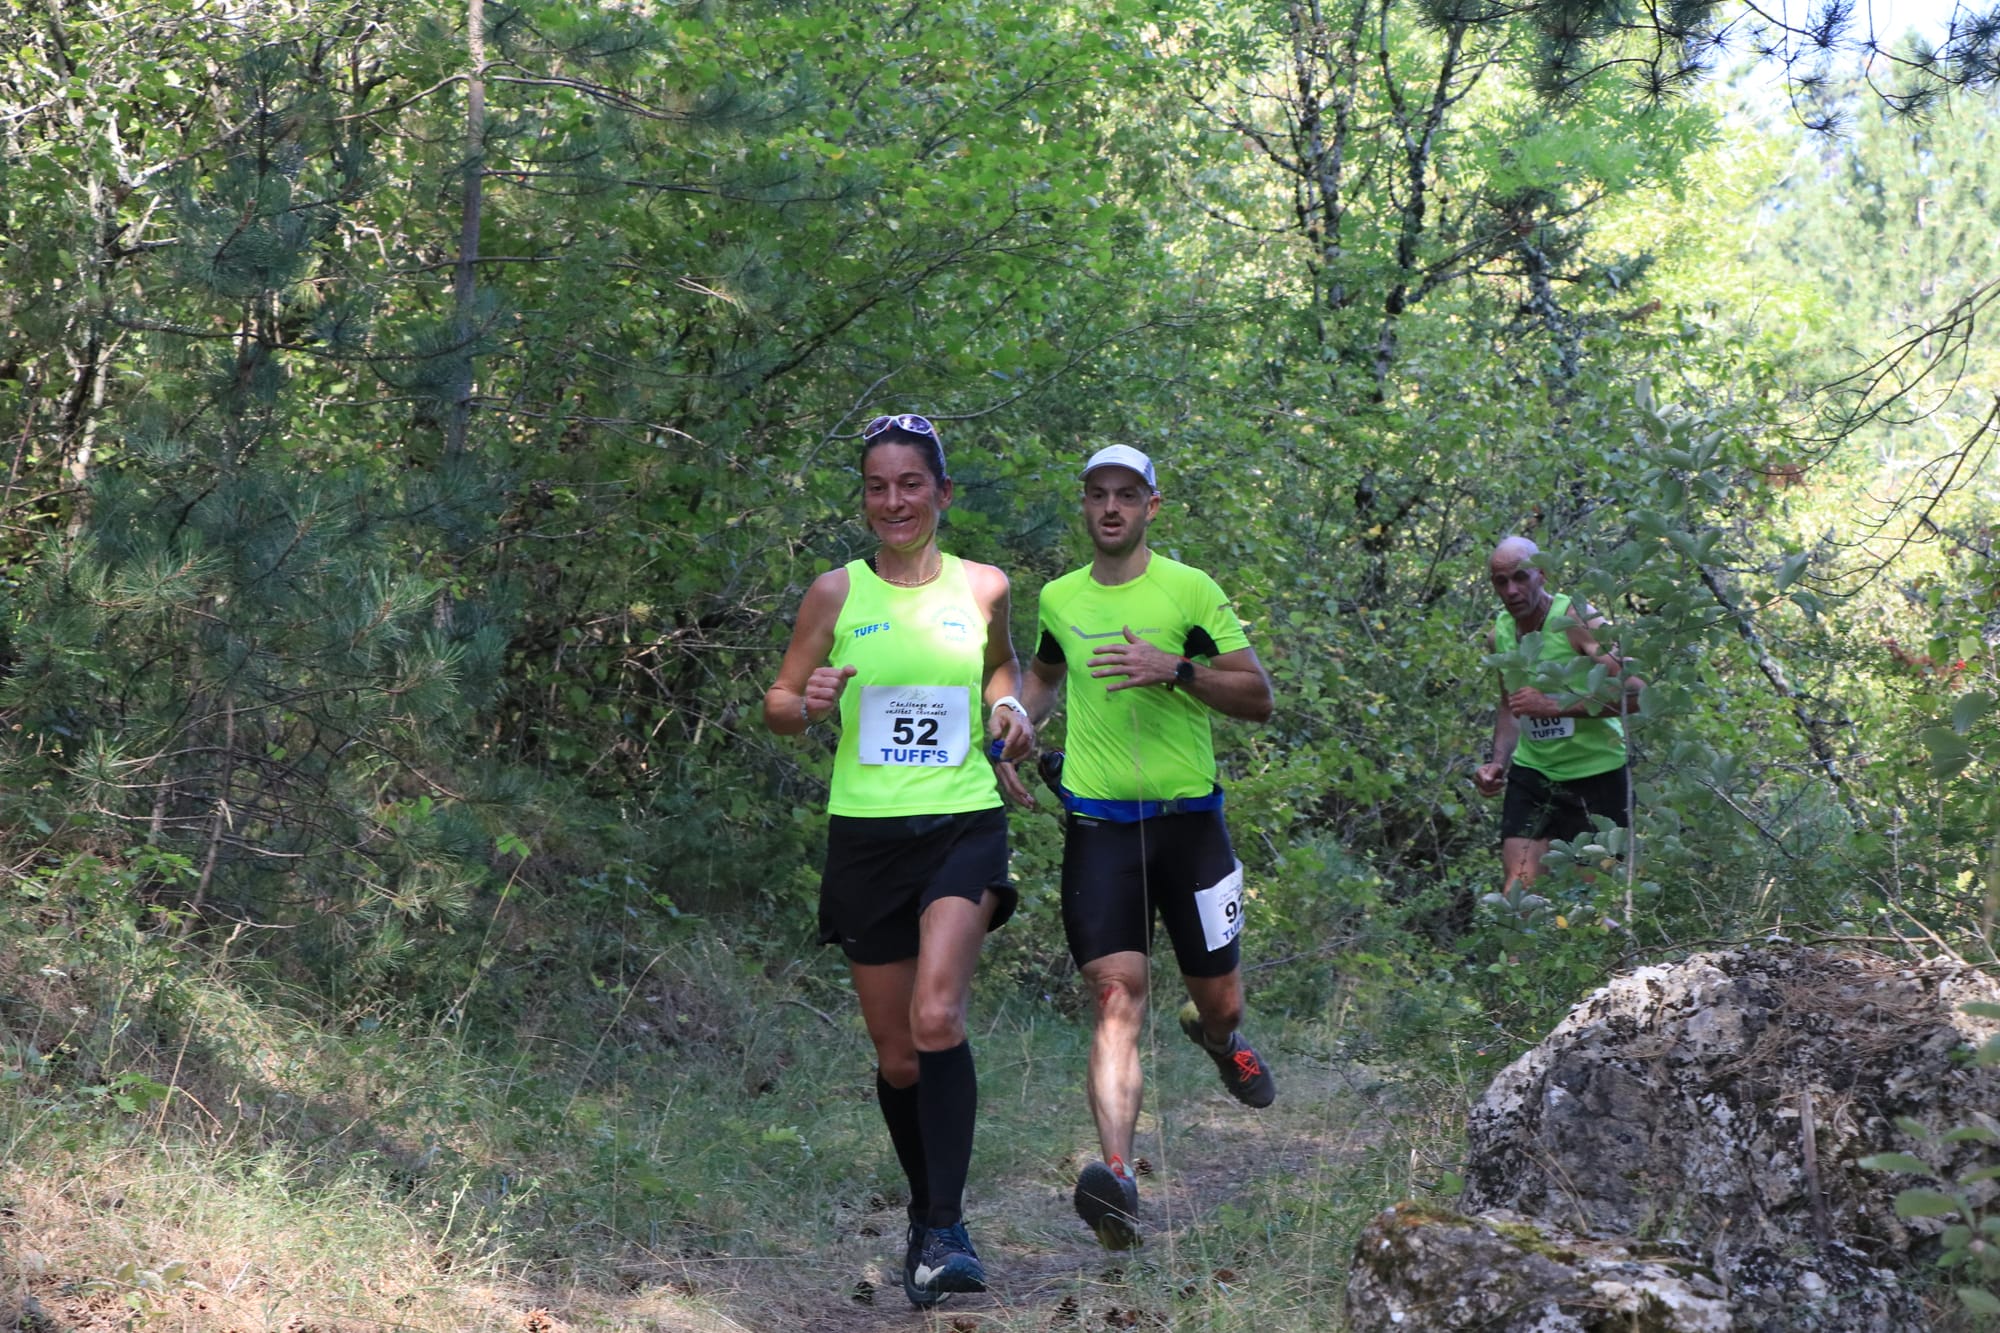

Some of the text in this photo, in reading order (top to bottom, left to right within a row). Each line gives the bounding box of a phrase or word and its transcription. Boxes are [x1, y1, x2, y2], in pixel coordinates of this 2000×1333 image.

[854, 622, 890, 638] TUFF'S
[892, 717, 939, 746] 52
[1531, 727, 1566, 738] TUFF'S
[880, 748, 949, 763] TUFF'S
